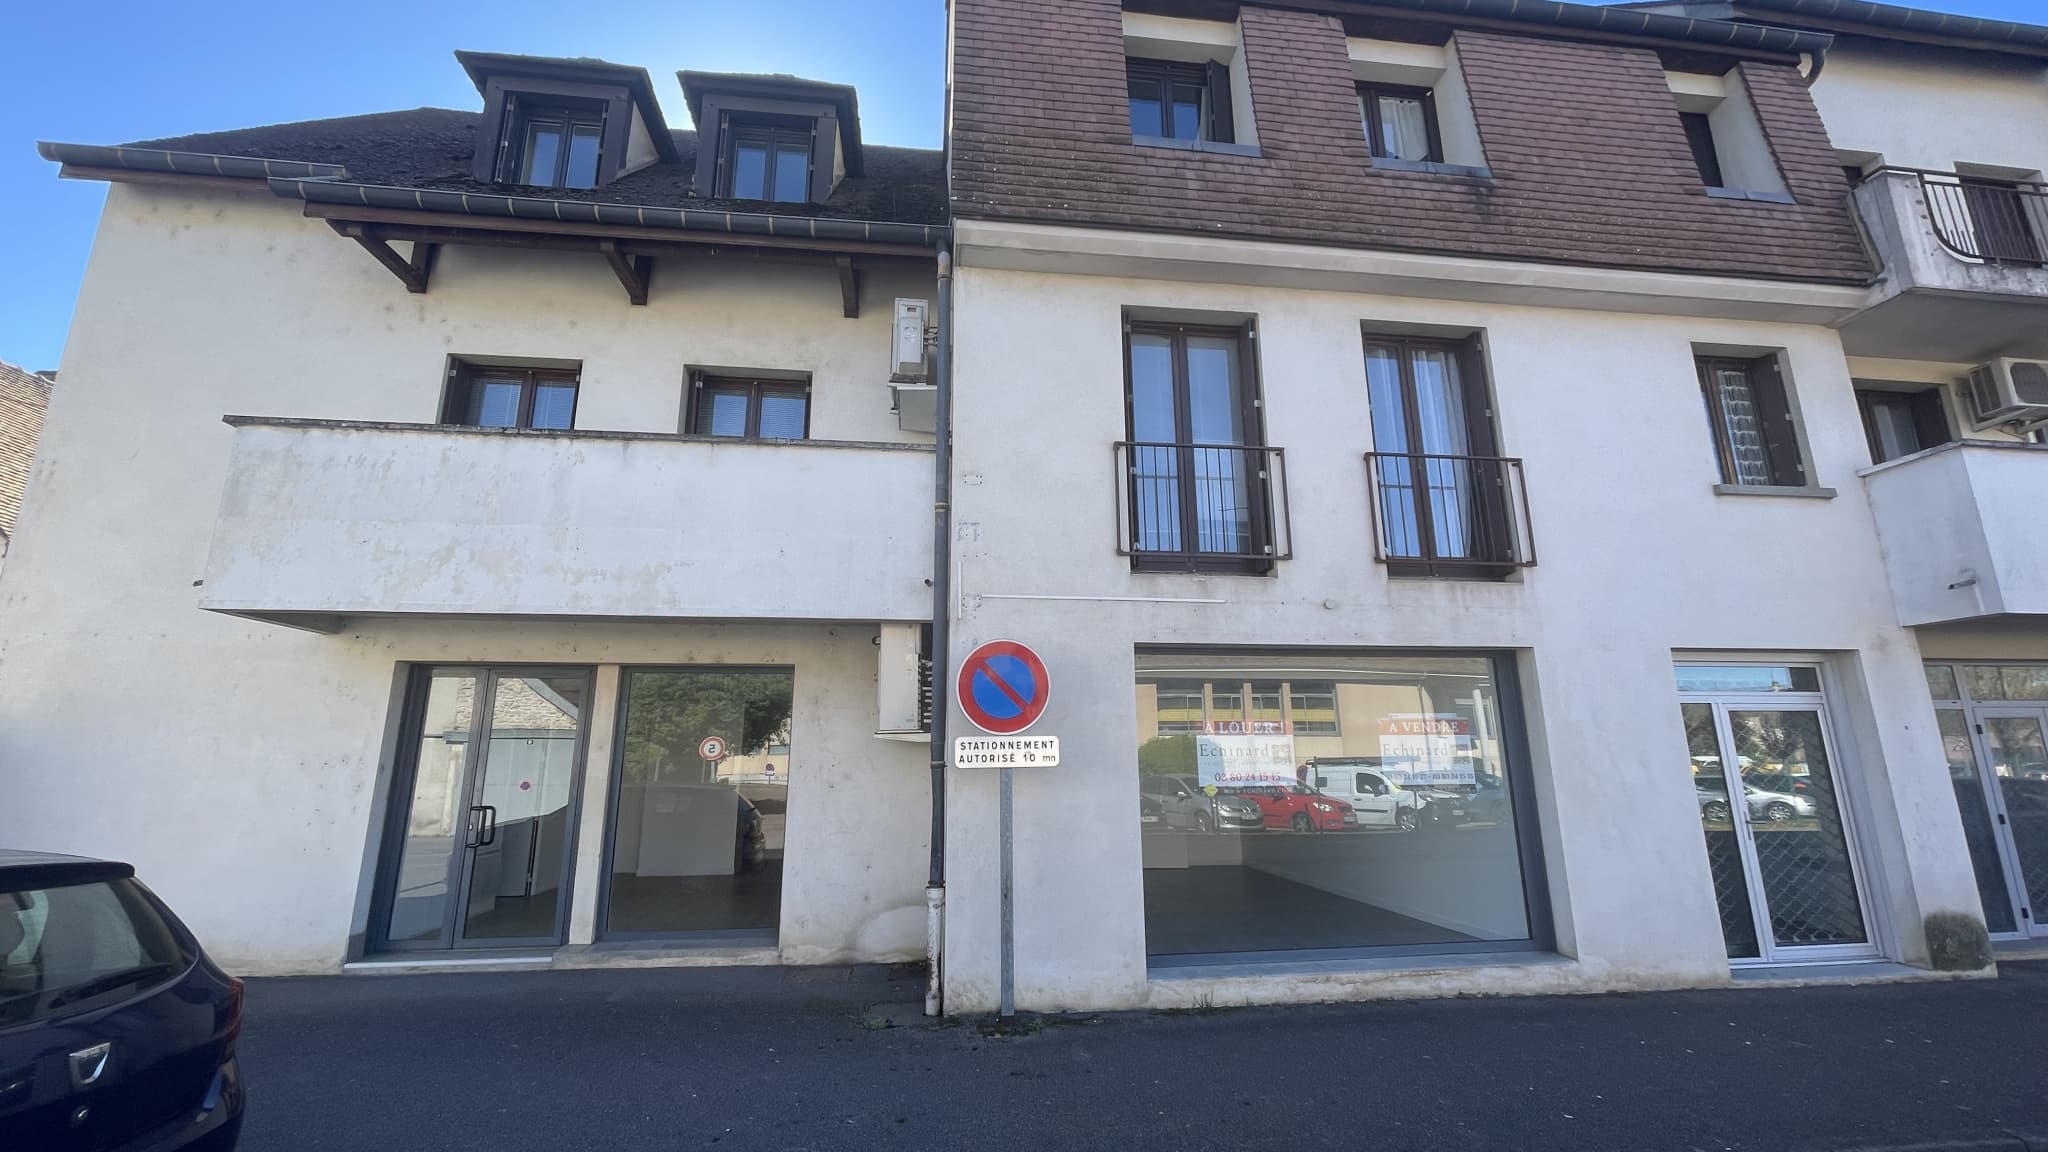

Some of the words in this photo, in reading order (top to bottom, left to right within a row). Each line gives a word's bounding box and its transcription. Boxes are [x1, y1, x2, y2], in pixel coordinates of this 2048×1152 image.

[1204, 722, 1215, 734] A
[1219, 721, 1273, 734] LOUER
[1390, 722, 1398, 733] A
[1403, 721, 1459, 733] VENDRE
[960, 741, 1055, 751] STATIONNEMENT
[1200, 743, 1269, 757] Echinard
[959, 752, 1016, 763] AUTORISÉ
[1023, 753, 1036, 762] 10
[1042, 754, 1056, 762] mn
[1245, 773, 1256, 781] 24
